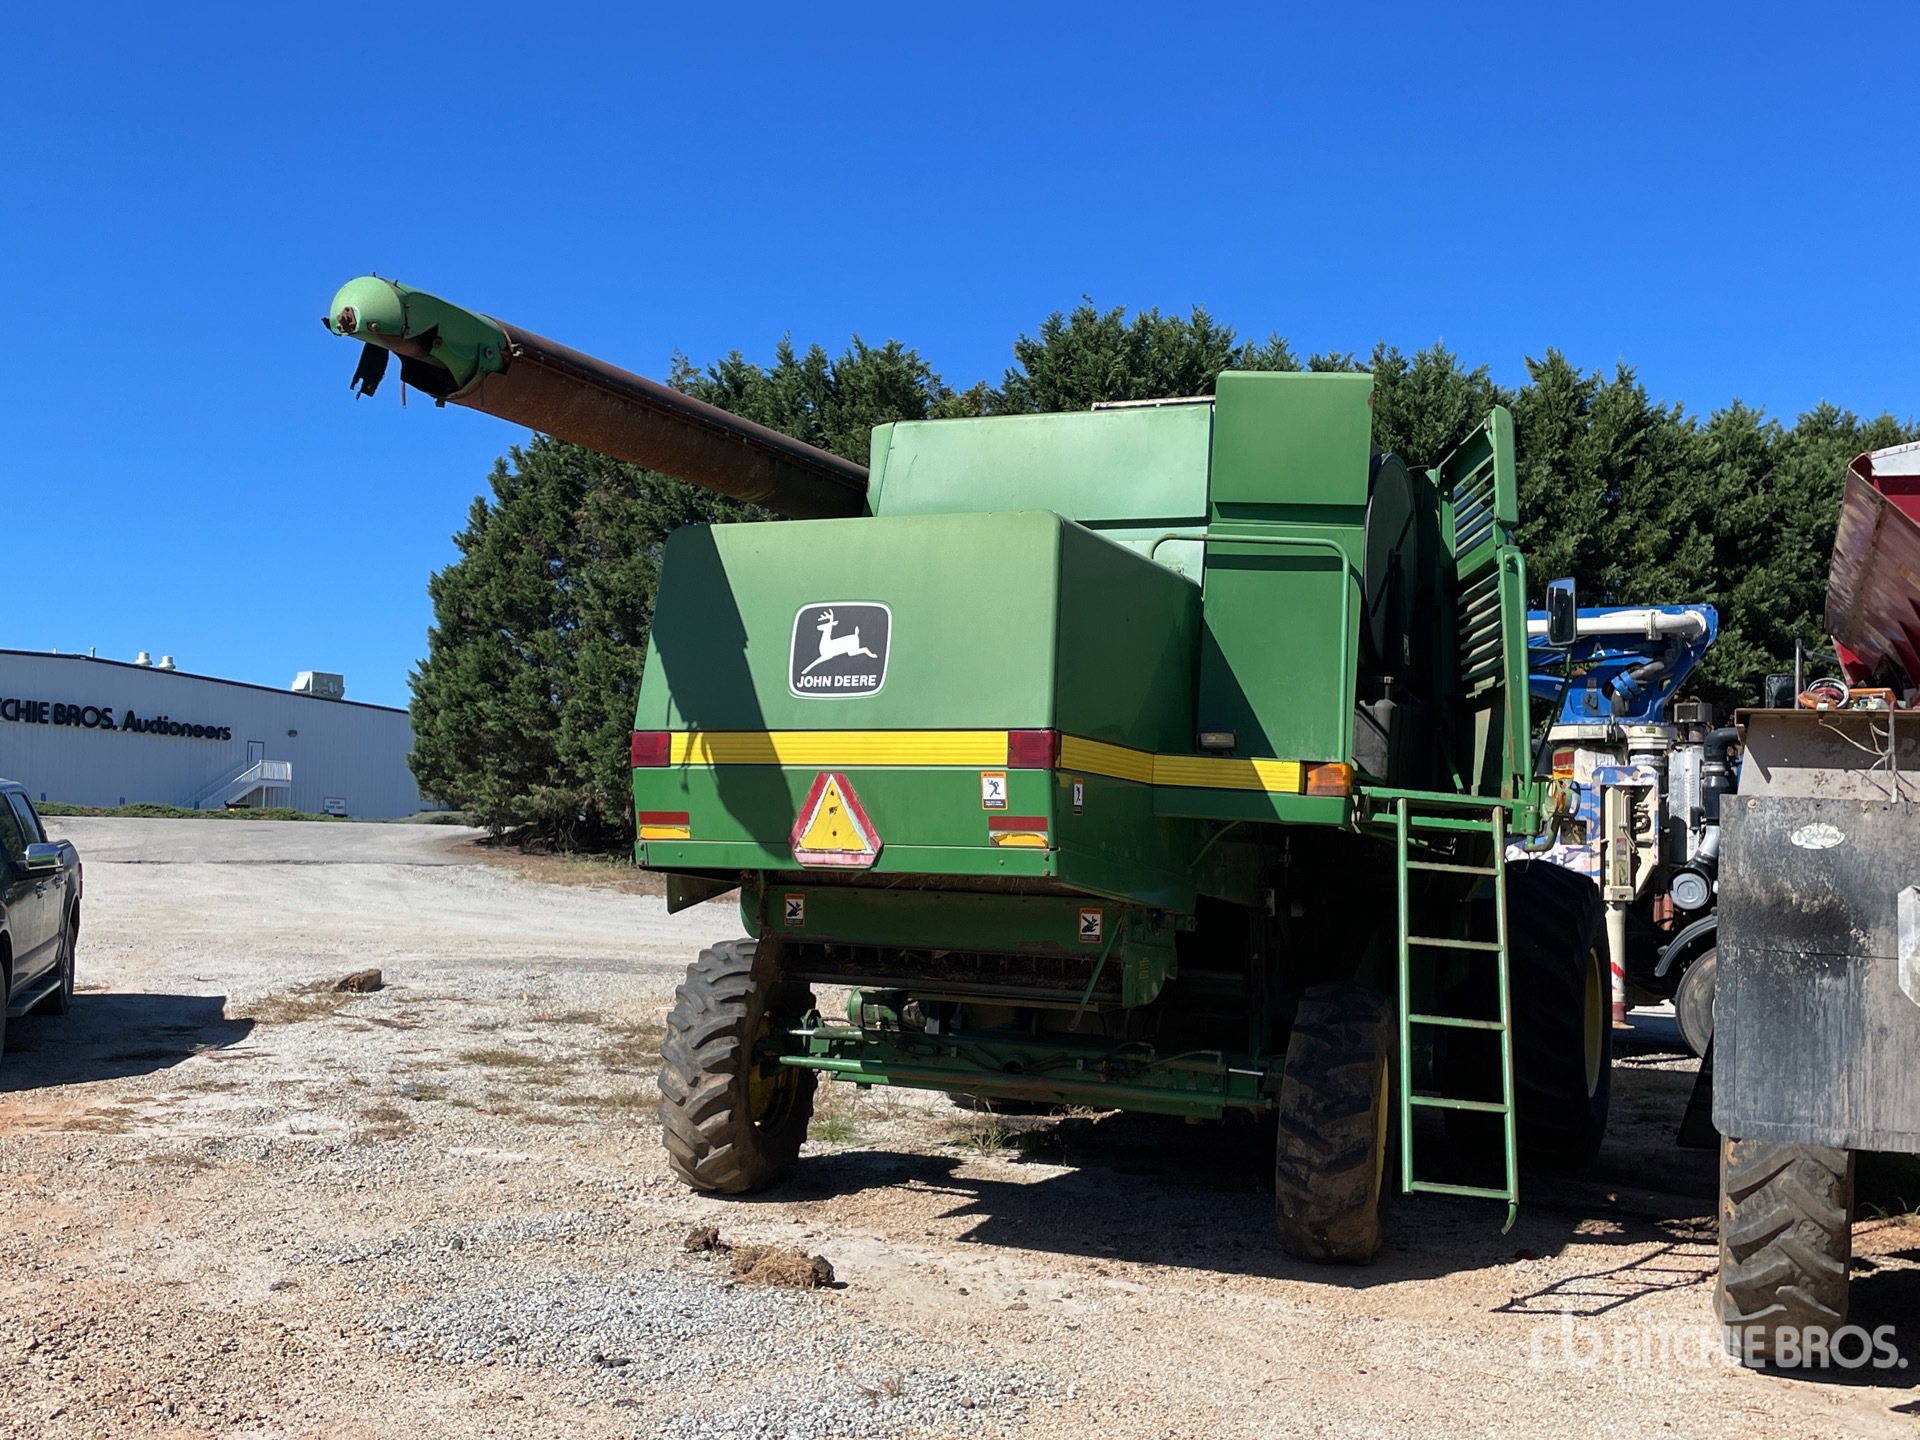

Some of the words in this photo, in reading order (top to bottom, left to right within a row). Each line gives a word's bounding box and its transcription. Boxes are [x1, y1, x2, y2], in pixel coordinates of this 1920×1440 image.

[796, 675, 832, 688] JOHN
[834, 674, 877, 687] DEERE
[0, 698, 50, 724] CHIE
[53, 703, 118, 730] BROS.
[122, 709, 232, 741] Auctioneers
